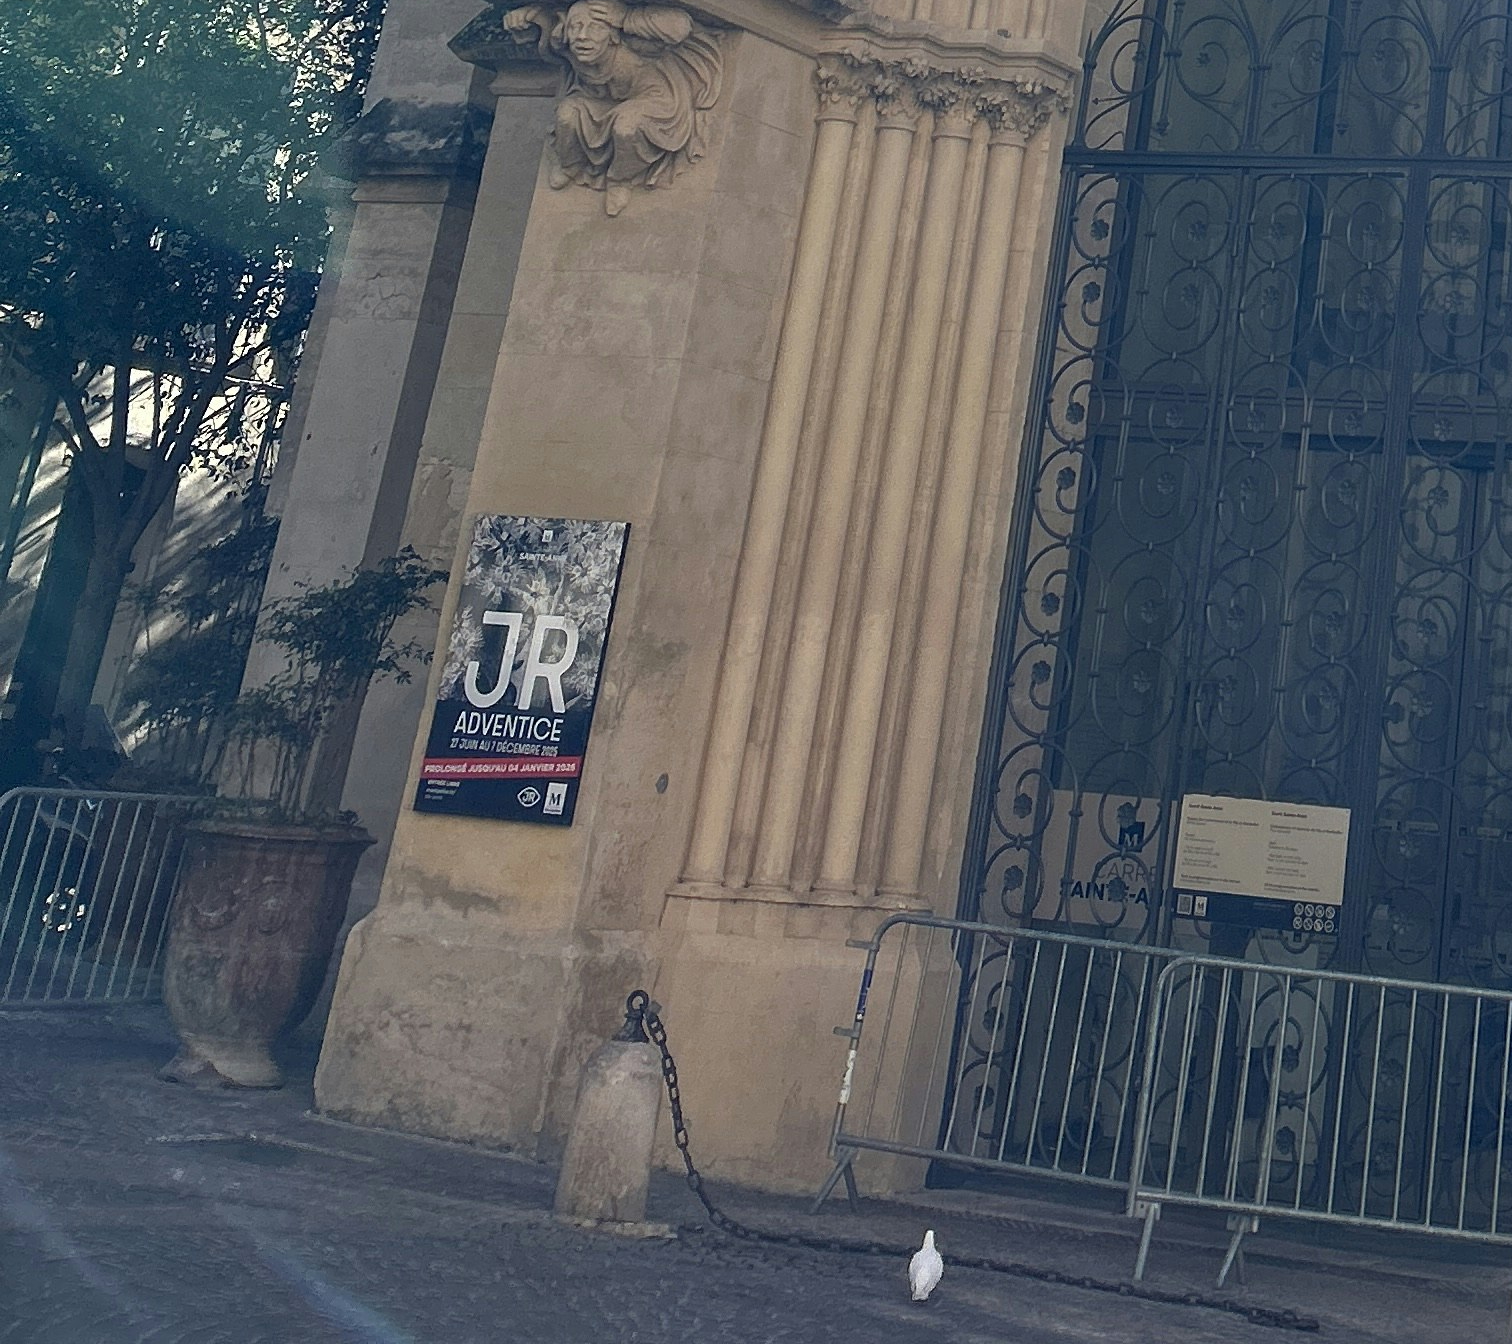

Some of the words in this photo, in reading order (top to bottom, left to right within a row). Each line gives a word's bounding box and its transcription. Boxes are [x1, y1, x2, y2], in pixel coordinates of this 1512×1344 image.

[464, 610, 579, 714] JR
[453, 710, 564, 743] ADVENTICE
[478, 740, 490, 752] AU
[519, 763, 555, 773] JANVIER
[522, 791, 536, 803] JR
[549, 792, 562, 806] M
[1123, 833, 1139, 848] M
